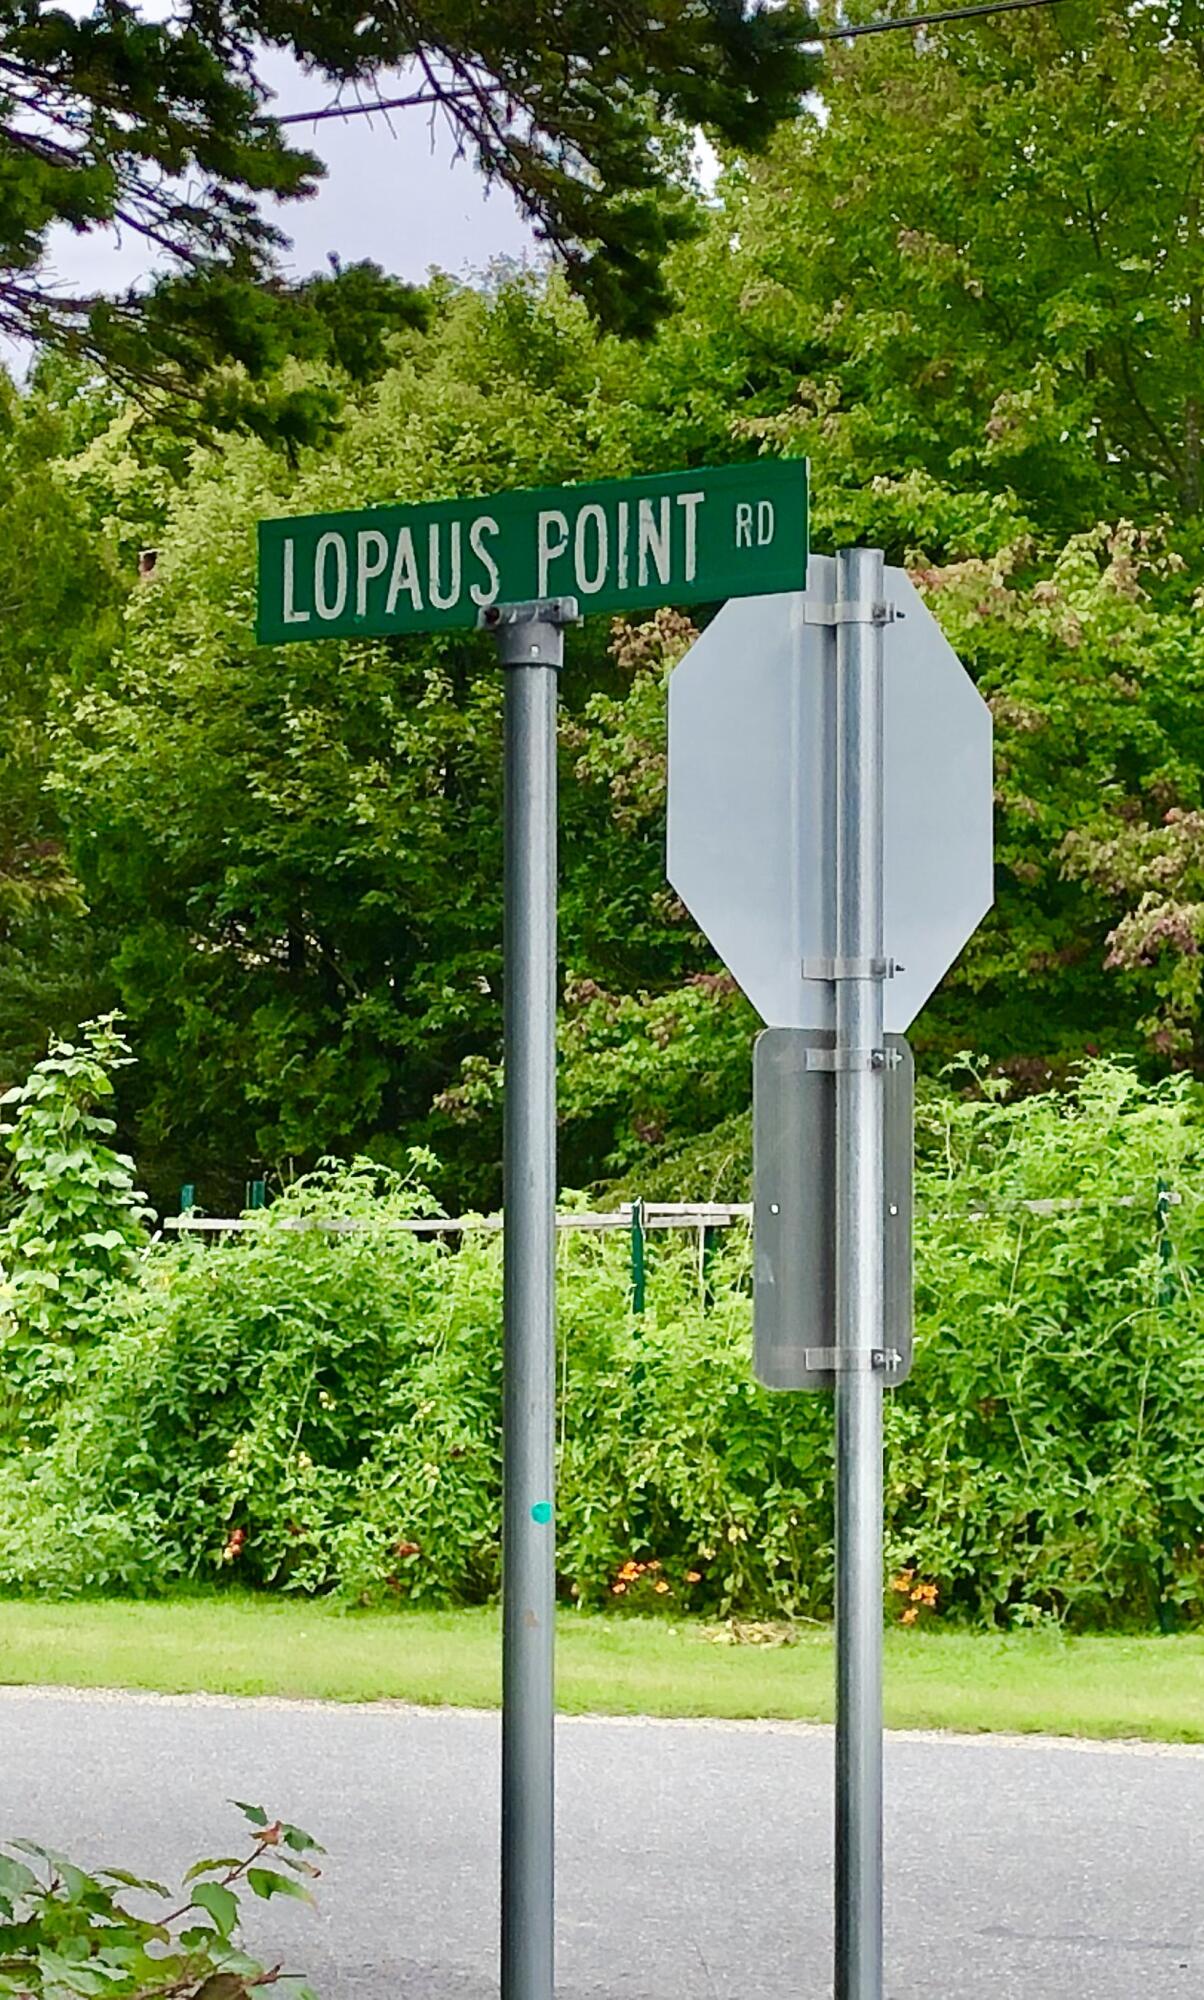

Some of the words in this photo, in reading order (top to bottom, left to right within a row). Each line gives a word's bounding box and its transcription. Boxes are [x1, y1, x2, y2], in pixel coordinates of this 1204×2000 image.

[283, 516, 500, 623] LOPAUS
[538, 492, 704, 598] POINT
[735, 501, 774, 548] RD
